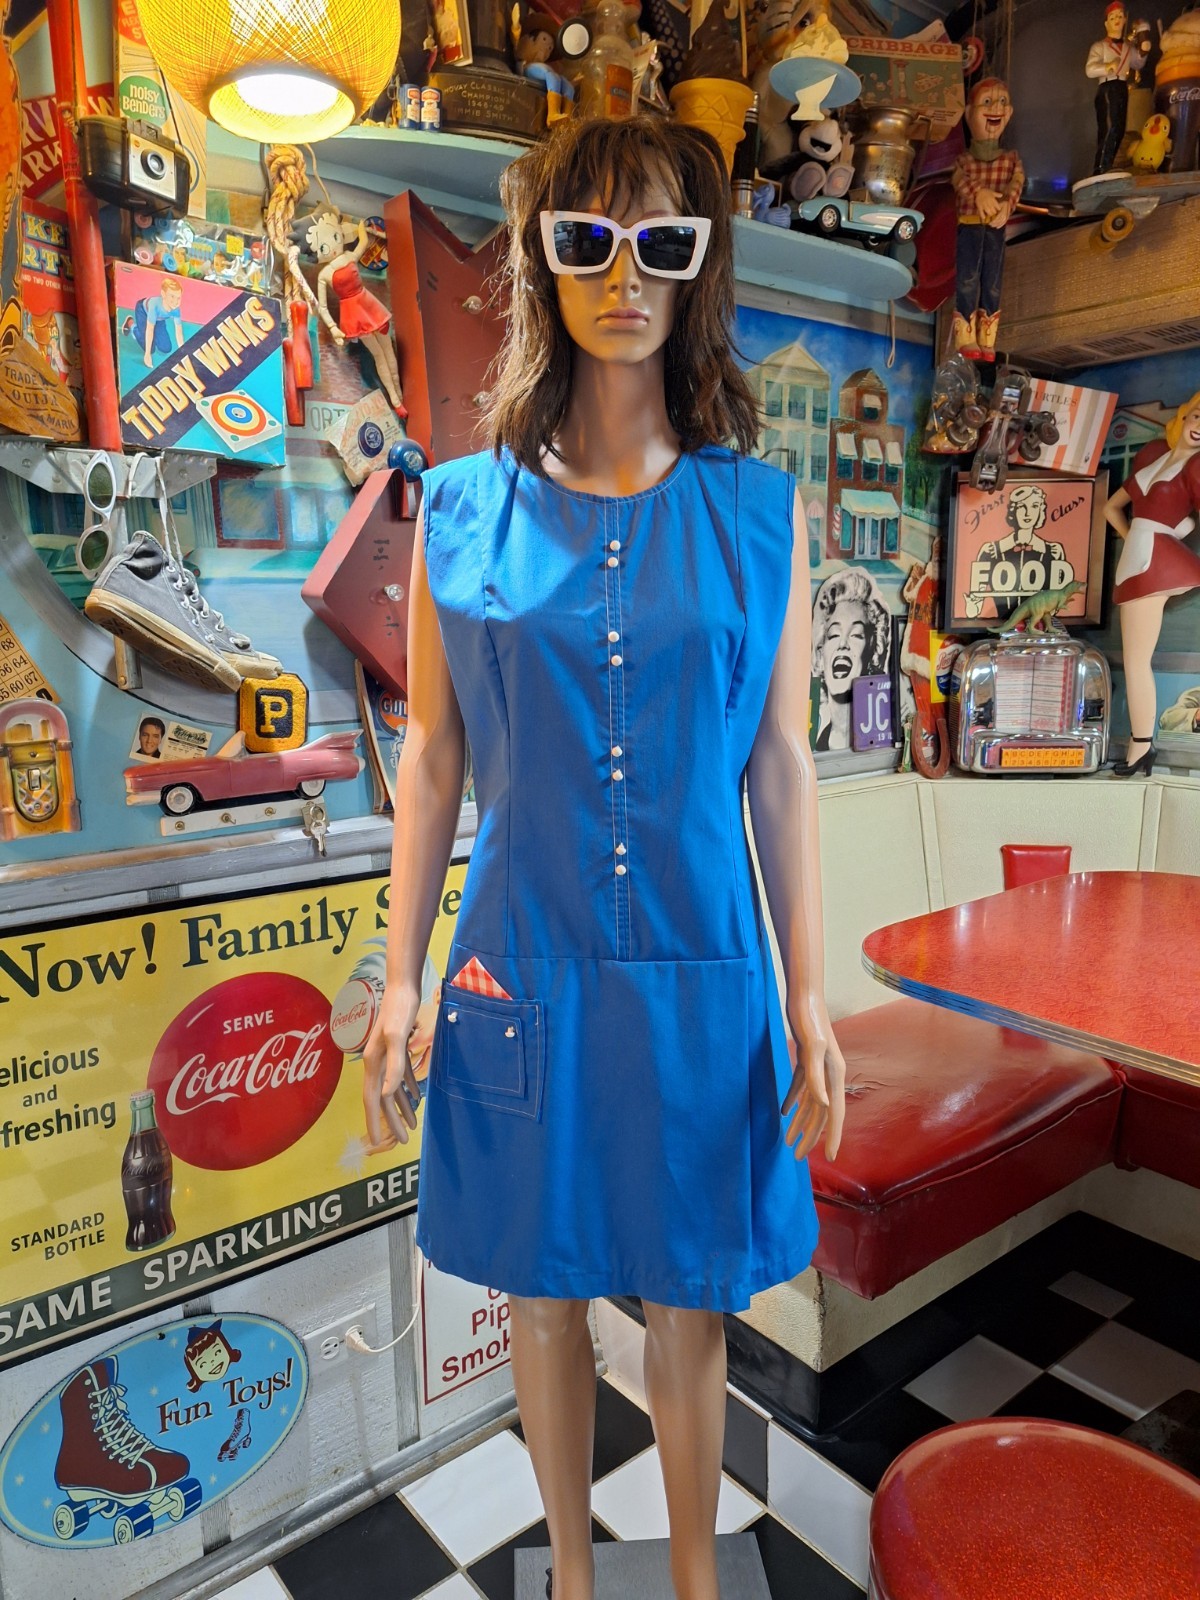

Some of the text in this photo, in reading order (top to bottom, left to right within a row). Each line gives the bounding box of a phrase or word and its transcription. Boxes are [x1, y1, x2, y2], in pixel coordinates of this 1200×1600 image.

[847, 39, 958, 56] CRIBBAGE
[4, 365, 38, 386] TRADE
[120, 296, 275, 441] TIDDLY WINKS
[11, 388, 59, 407] OUIJA
[46, 413, 77, 430] MARK
[964, 493, 1085, 535] First Class
[970, 559, 1075, 592] FOOD
[1, 637, 15, 651] 68
[12, 654, 28, 669] 64
[9, 679, 24, 694] 60
[23, 670, 38, 685] 67
[260, 694, 288, 733] P
[860, 691, 889, 734] JC
[0, 922, 157, 1003] Now!
[180, 896, 359, 968] Family
[223, 1009, 275, 1035] SERVE
[165, 1022, 328, 1116] Coca-Cola
[22, 1084, 58, 1108] and
[10, 1211, 105, 1252] STANDARD
[44, 1229, 106, 1261] BOTTLE
[0, 1275, 112, 1345] SAME
[143, 1194, 343, 1291] SPARKLING
[156, 1357, 293, 1435] Fun Toys!
